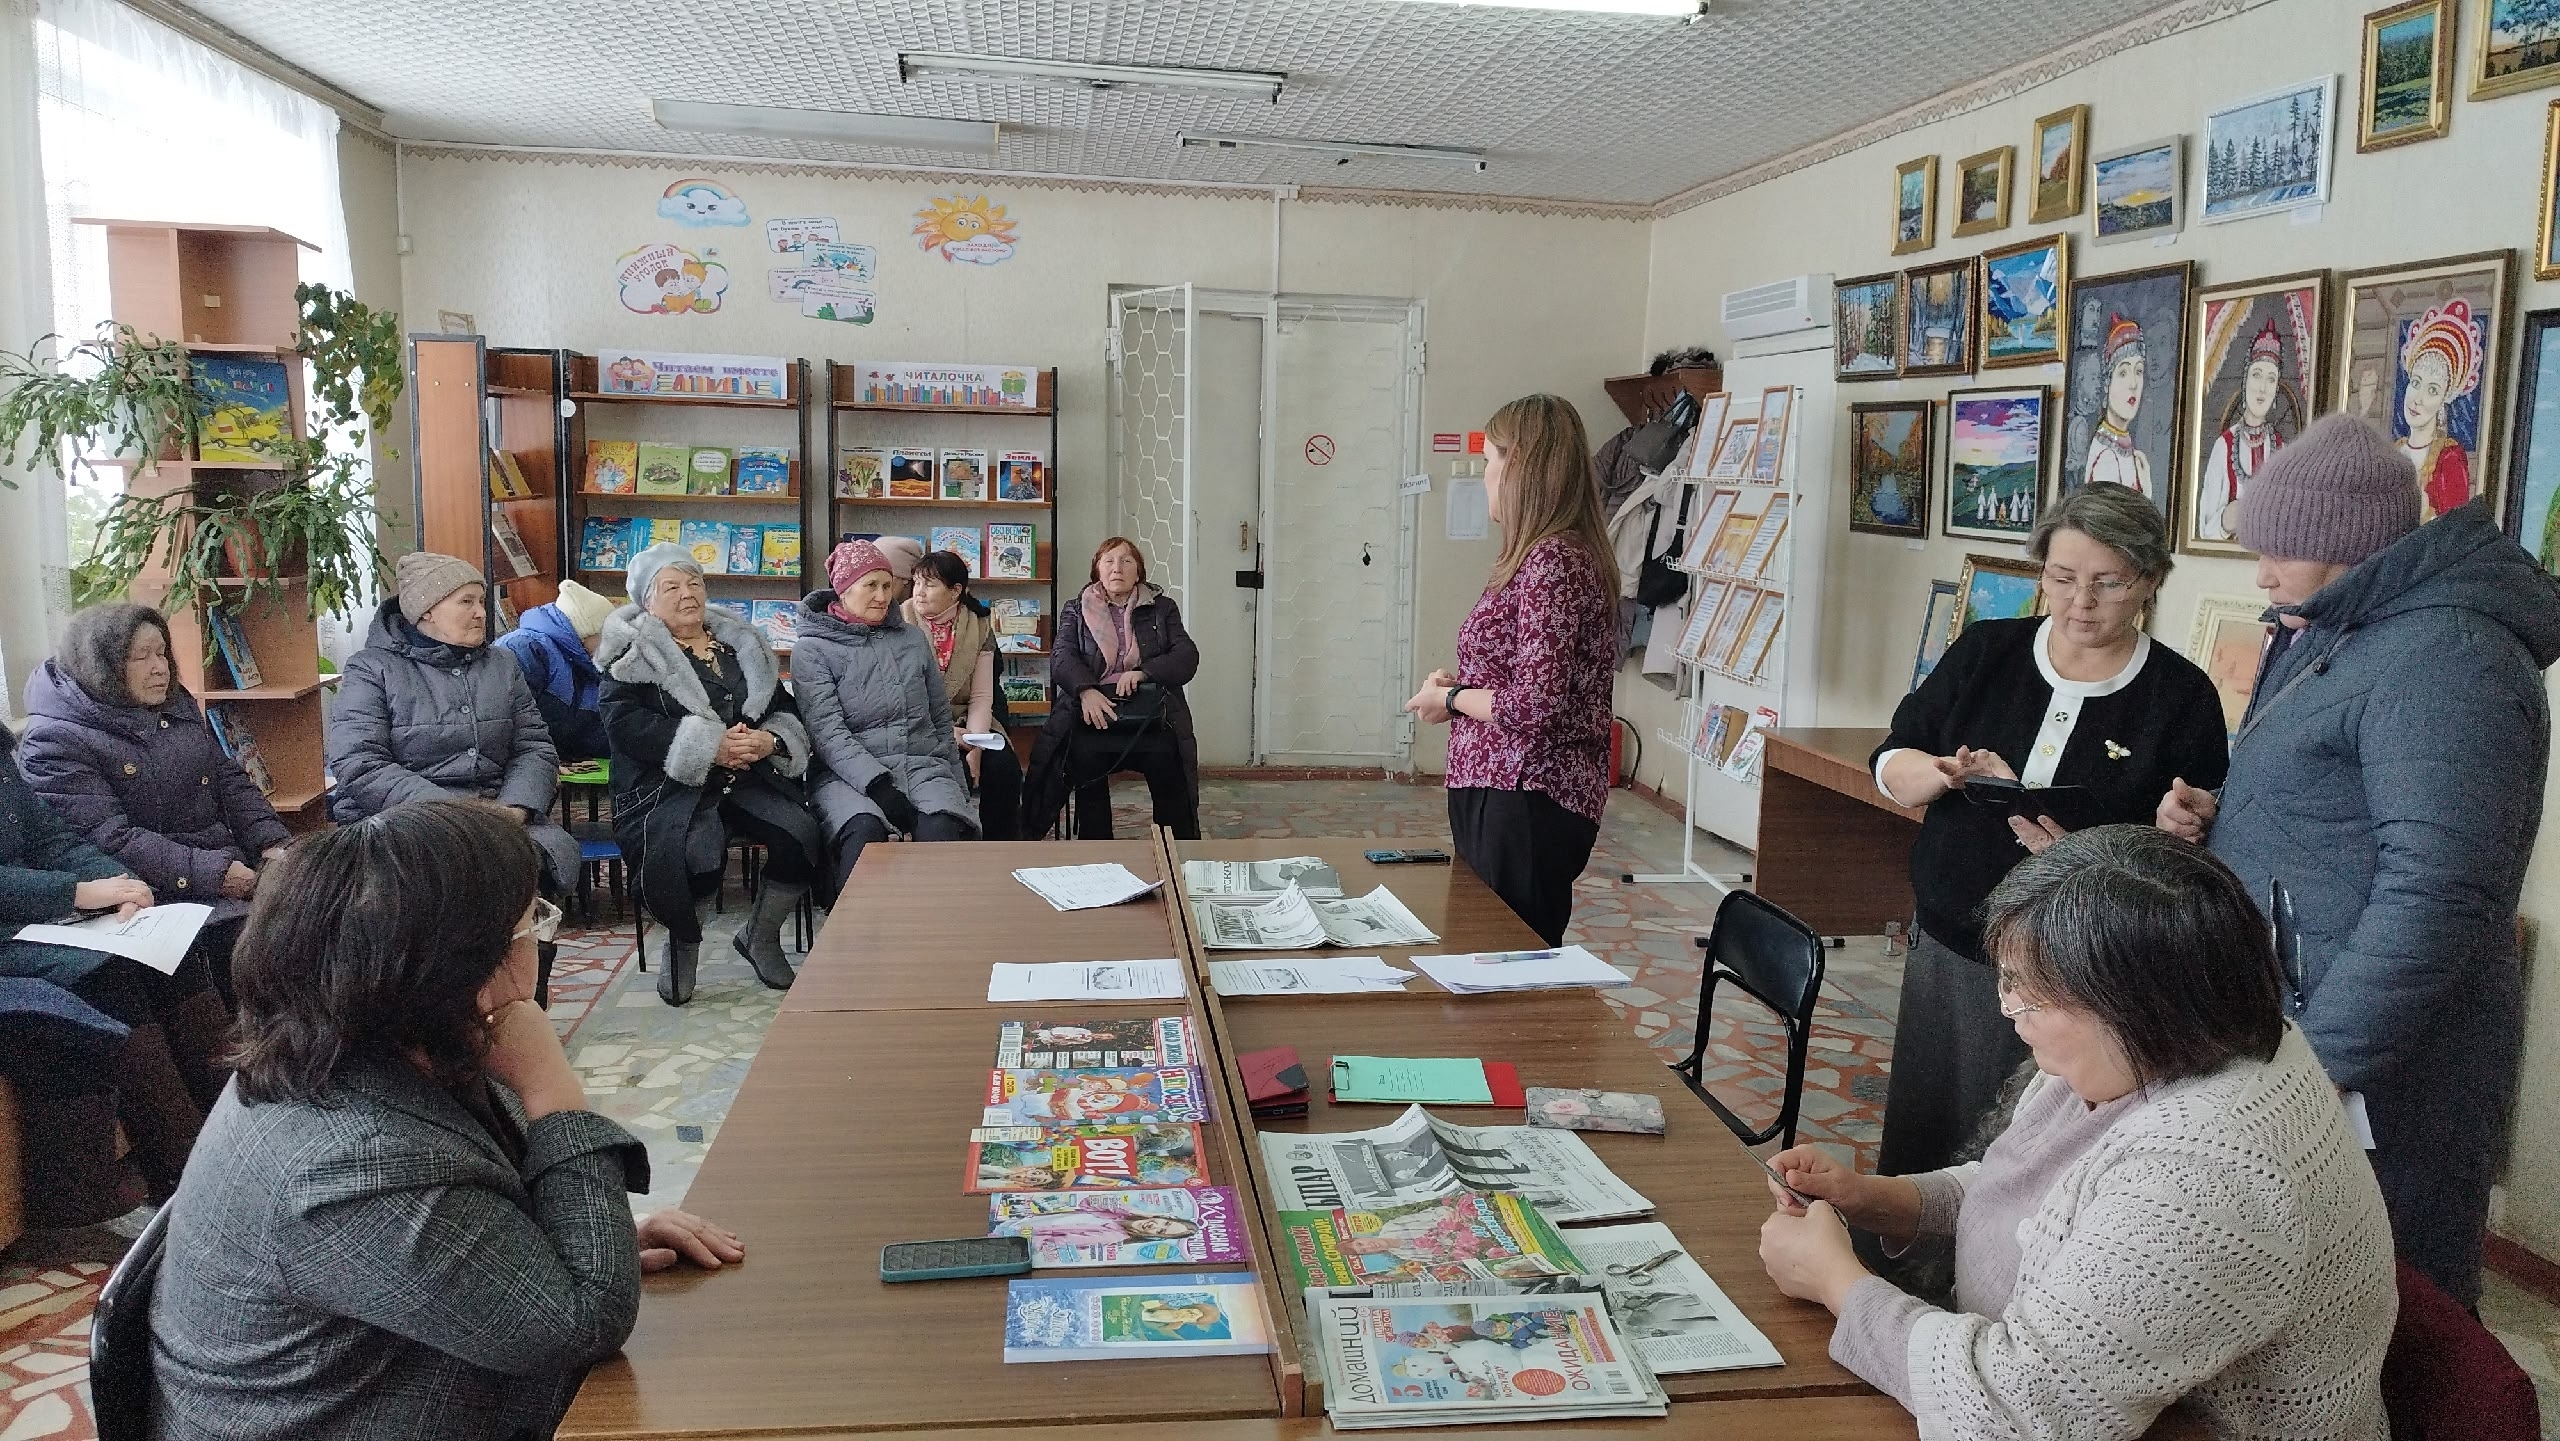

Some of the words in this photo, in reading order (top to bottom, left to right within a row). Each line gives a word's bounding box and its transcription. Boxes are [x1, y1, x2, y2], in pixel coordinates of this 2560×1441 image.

[619, 247, 675, 282] КНИЖНЫЙ
[633, 259, 669, 282] УГОЛОК
[652, 361, 714, 375] Читаем
[721, 366, 779, 377] вместе
[905, 370, 983, 382] ЧИТАЛОЧКА
[1004, 453, 1038, 461] Земля
[1083, 1138, 1131, 1176] ВОТ!
[1287, 1226, 1321, 1267] УРОЖАЙ!
[1371, 1309, 1384, 1338] ПИЦЦА
[1330, 1306, 1378, 1404] Домашний
[1391, 1384, 1424, 1397] 5
